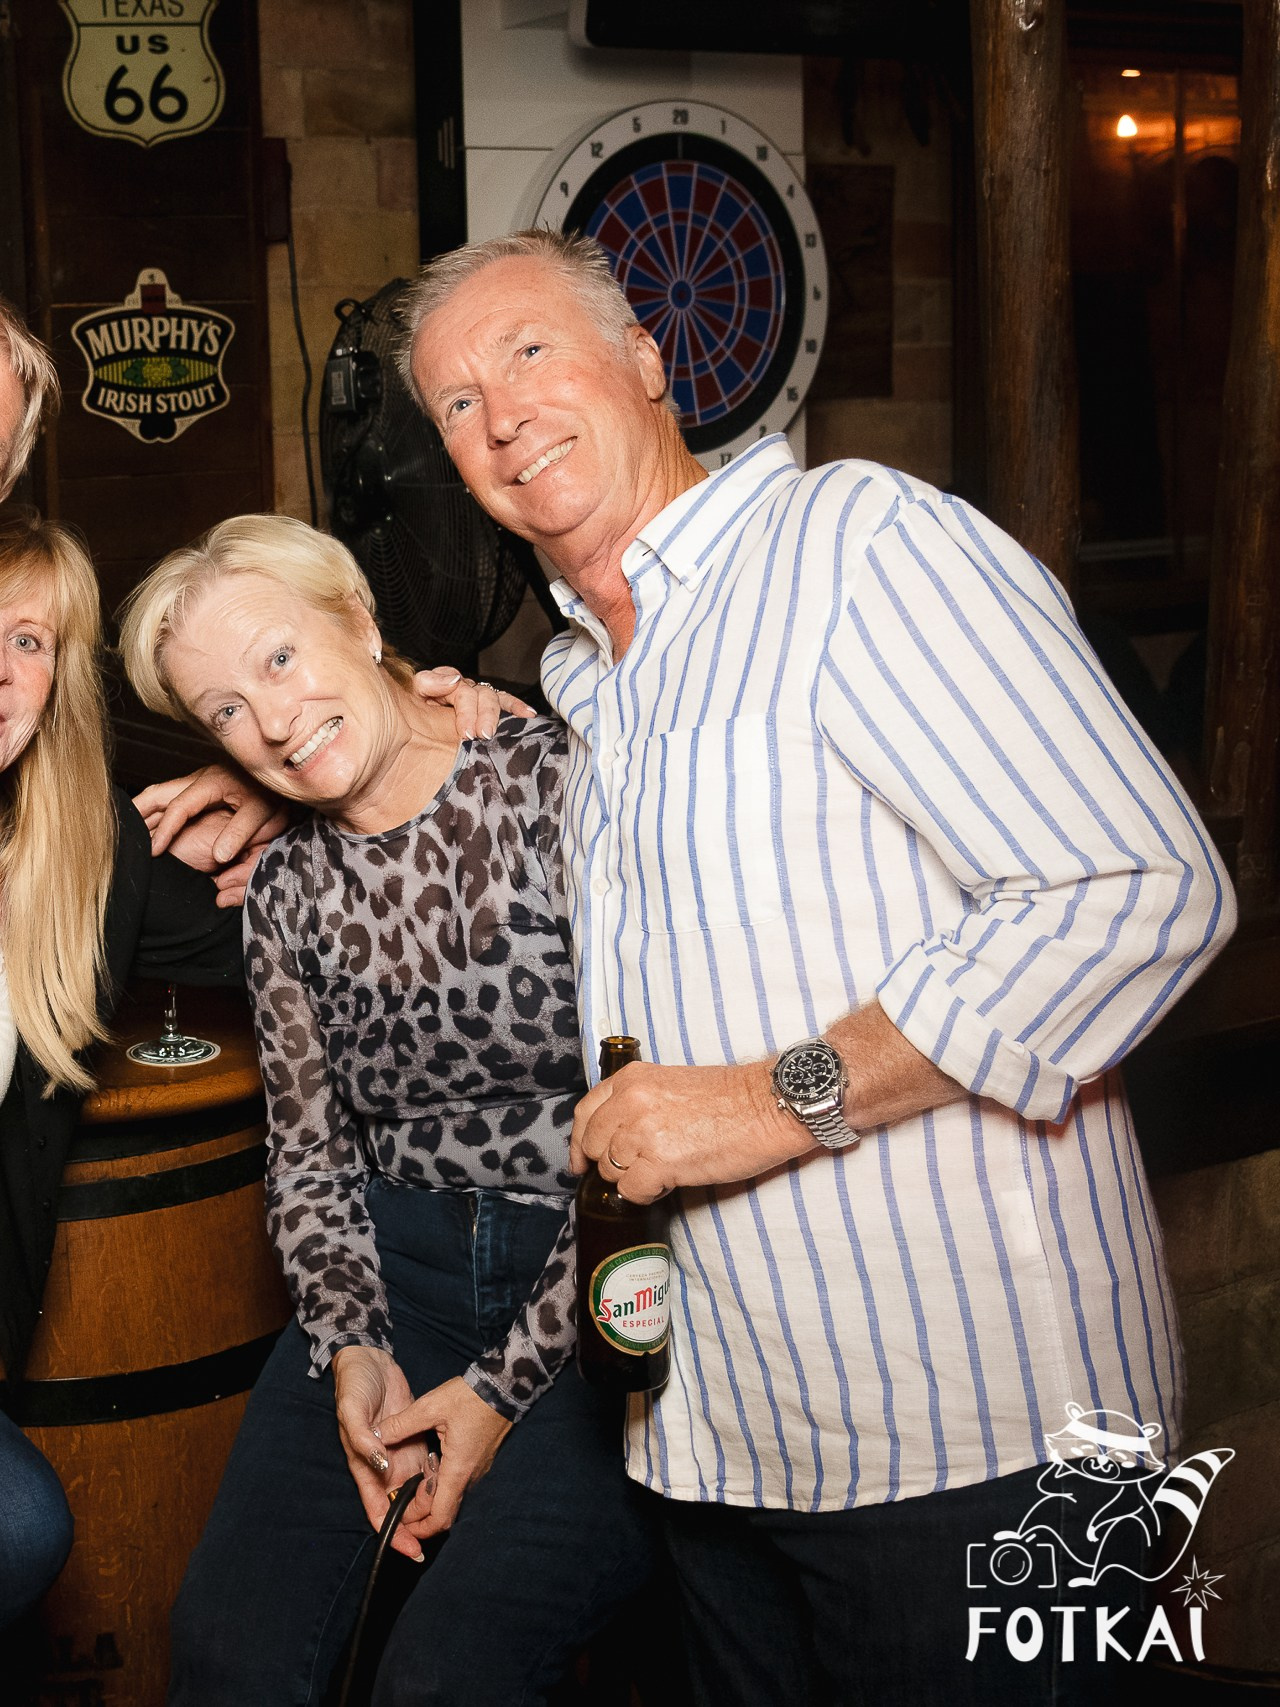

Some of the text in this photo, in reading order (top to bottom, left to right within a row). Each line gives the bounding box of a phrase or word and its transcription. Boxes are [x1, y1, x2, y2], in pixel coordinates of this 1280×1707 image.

[116, 34, 170, 54] US
[104, 64, 188, 124] 66
[632, 117, 641, 132] 5
[672, 108, 689, 125] 20
[720, 119, 727, 134] 1
[590, 142, 604, 158] 12
[756, 145, 768, 161] 18
[560, 181, 569, 198] 9
[786, 184, 795, 199] 4
[805, 233, 817, 248] 13
[812, 286, 821, 301] 6
[84, 315, 222, 361] MURPHY'S
[806, 338, 817, 354] 10
[97, 383, 217, 414] IRISH STOUT
[786, 386, 799, 402] 15
[720, 452, 732, 467] 17
[622, 1316, 665, 1328] ESPECIAL
